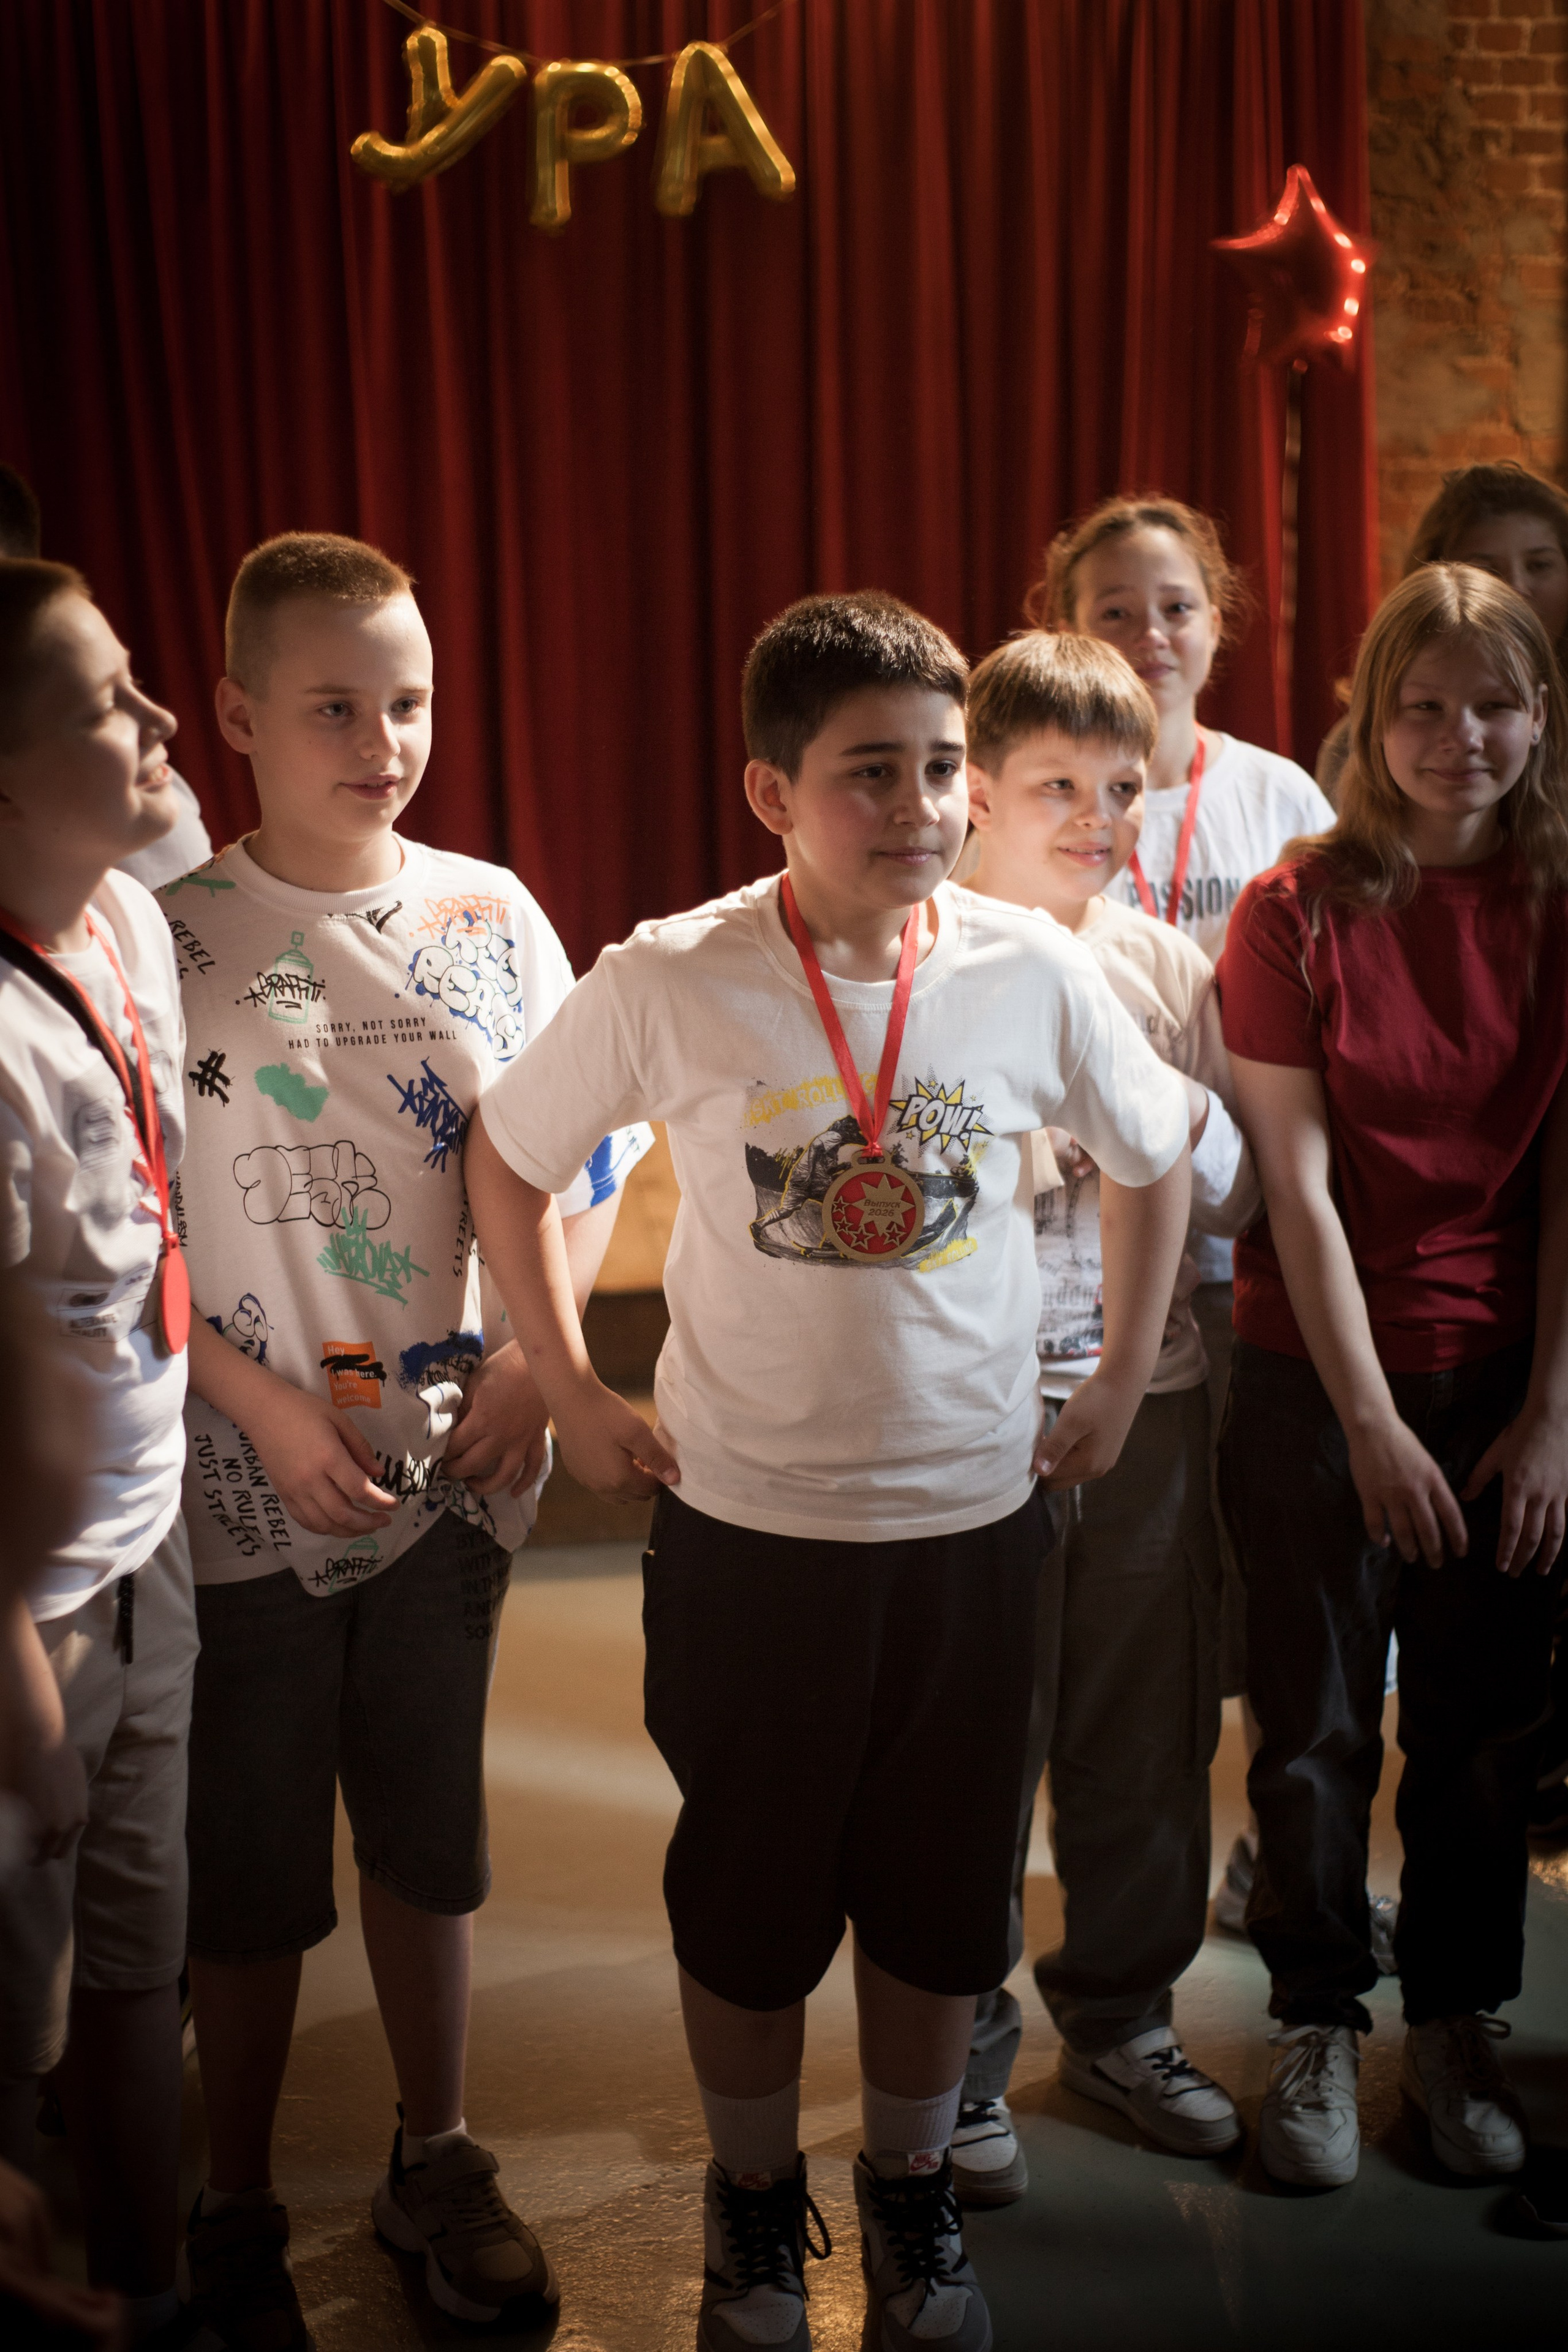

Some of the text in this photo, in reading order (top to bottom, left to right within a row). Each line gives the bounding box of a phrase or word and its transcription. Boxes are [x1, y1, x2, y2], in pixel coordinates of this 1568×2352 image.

[350, 26, 796, 230] УРА
[316, 1017, 426, 1034] SORRY, NOT SORRY
[288, 1030, 458, 1050] HAD TO UPGRADE YOUR WALL
[897, 1094, 983, 1141] POW!
[864, 1199, 900, 1208] Выпуск
[327, 1345, 345, 1356] Hey
[355, 1368, 377, 1378] here.
[334, 1380, 358, 1390] You're
[336, 1394, 371, 1404] welcome
[194, 1434, 222, 1482] JUST
[222, 1458, 243, 1483] NO
[260, 1494, 292, 1551] REBEL
